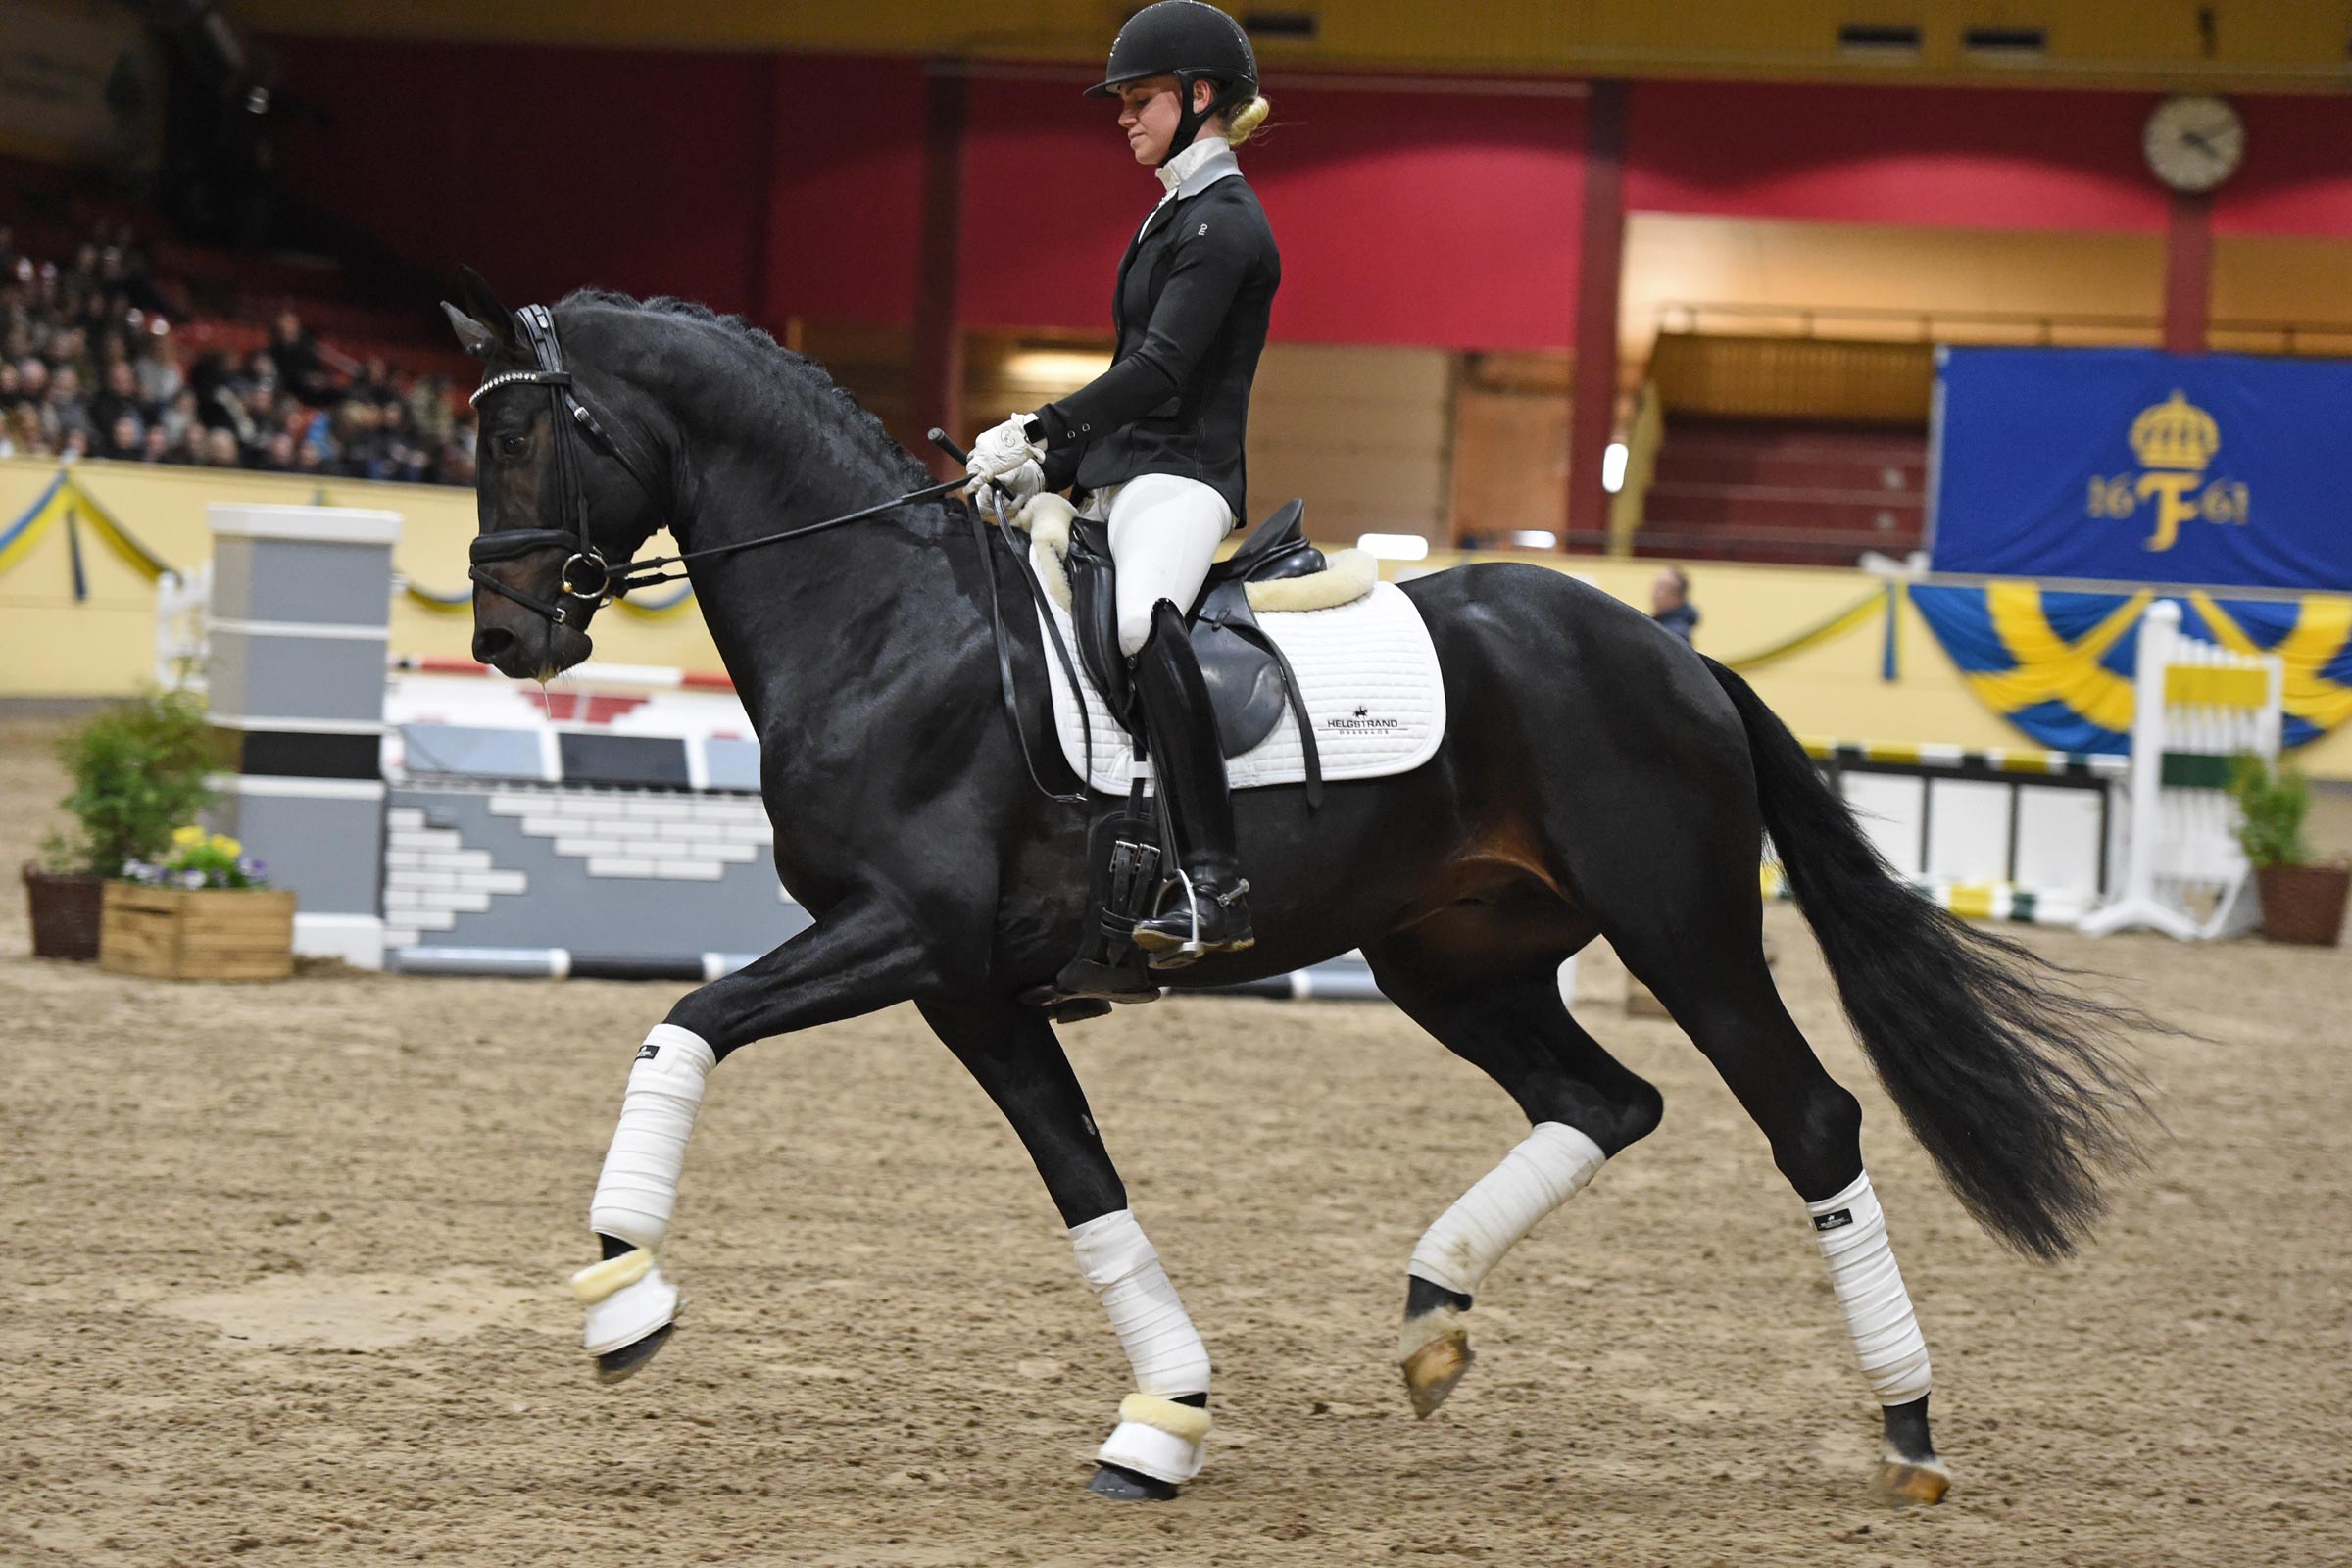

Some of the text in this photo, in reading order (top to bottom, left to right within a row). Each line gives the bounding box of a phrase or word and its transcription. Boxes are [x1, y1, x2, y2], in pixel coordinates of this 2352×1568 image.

[2087, 473, 2136, 519] 16
[2202, 477, 2250, 525] 61
[1327, 719, 1398, 728] HELGSTRAND
